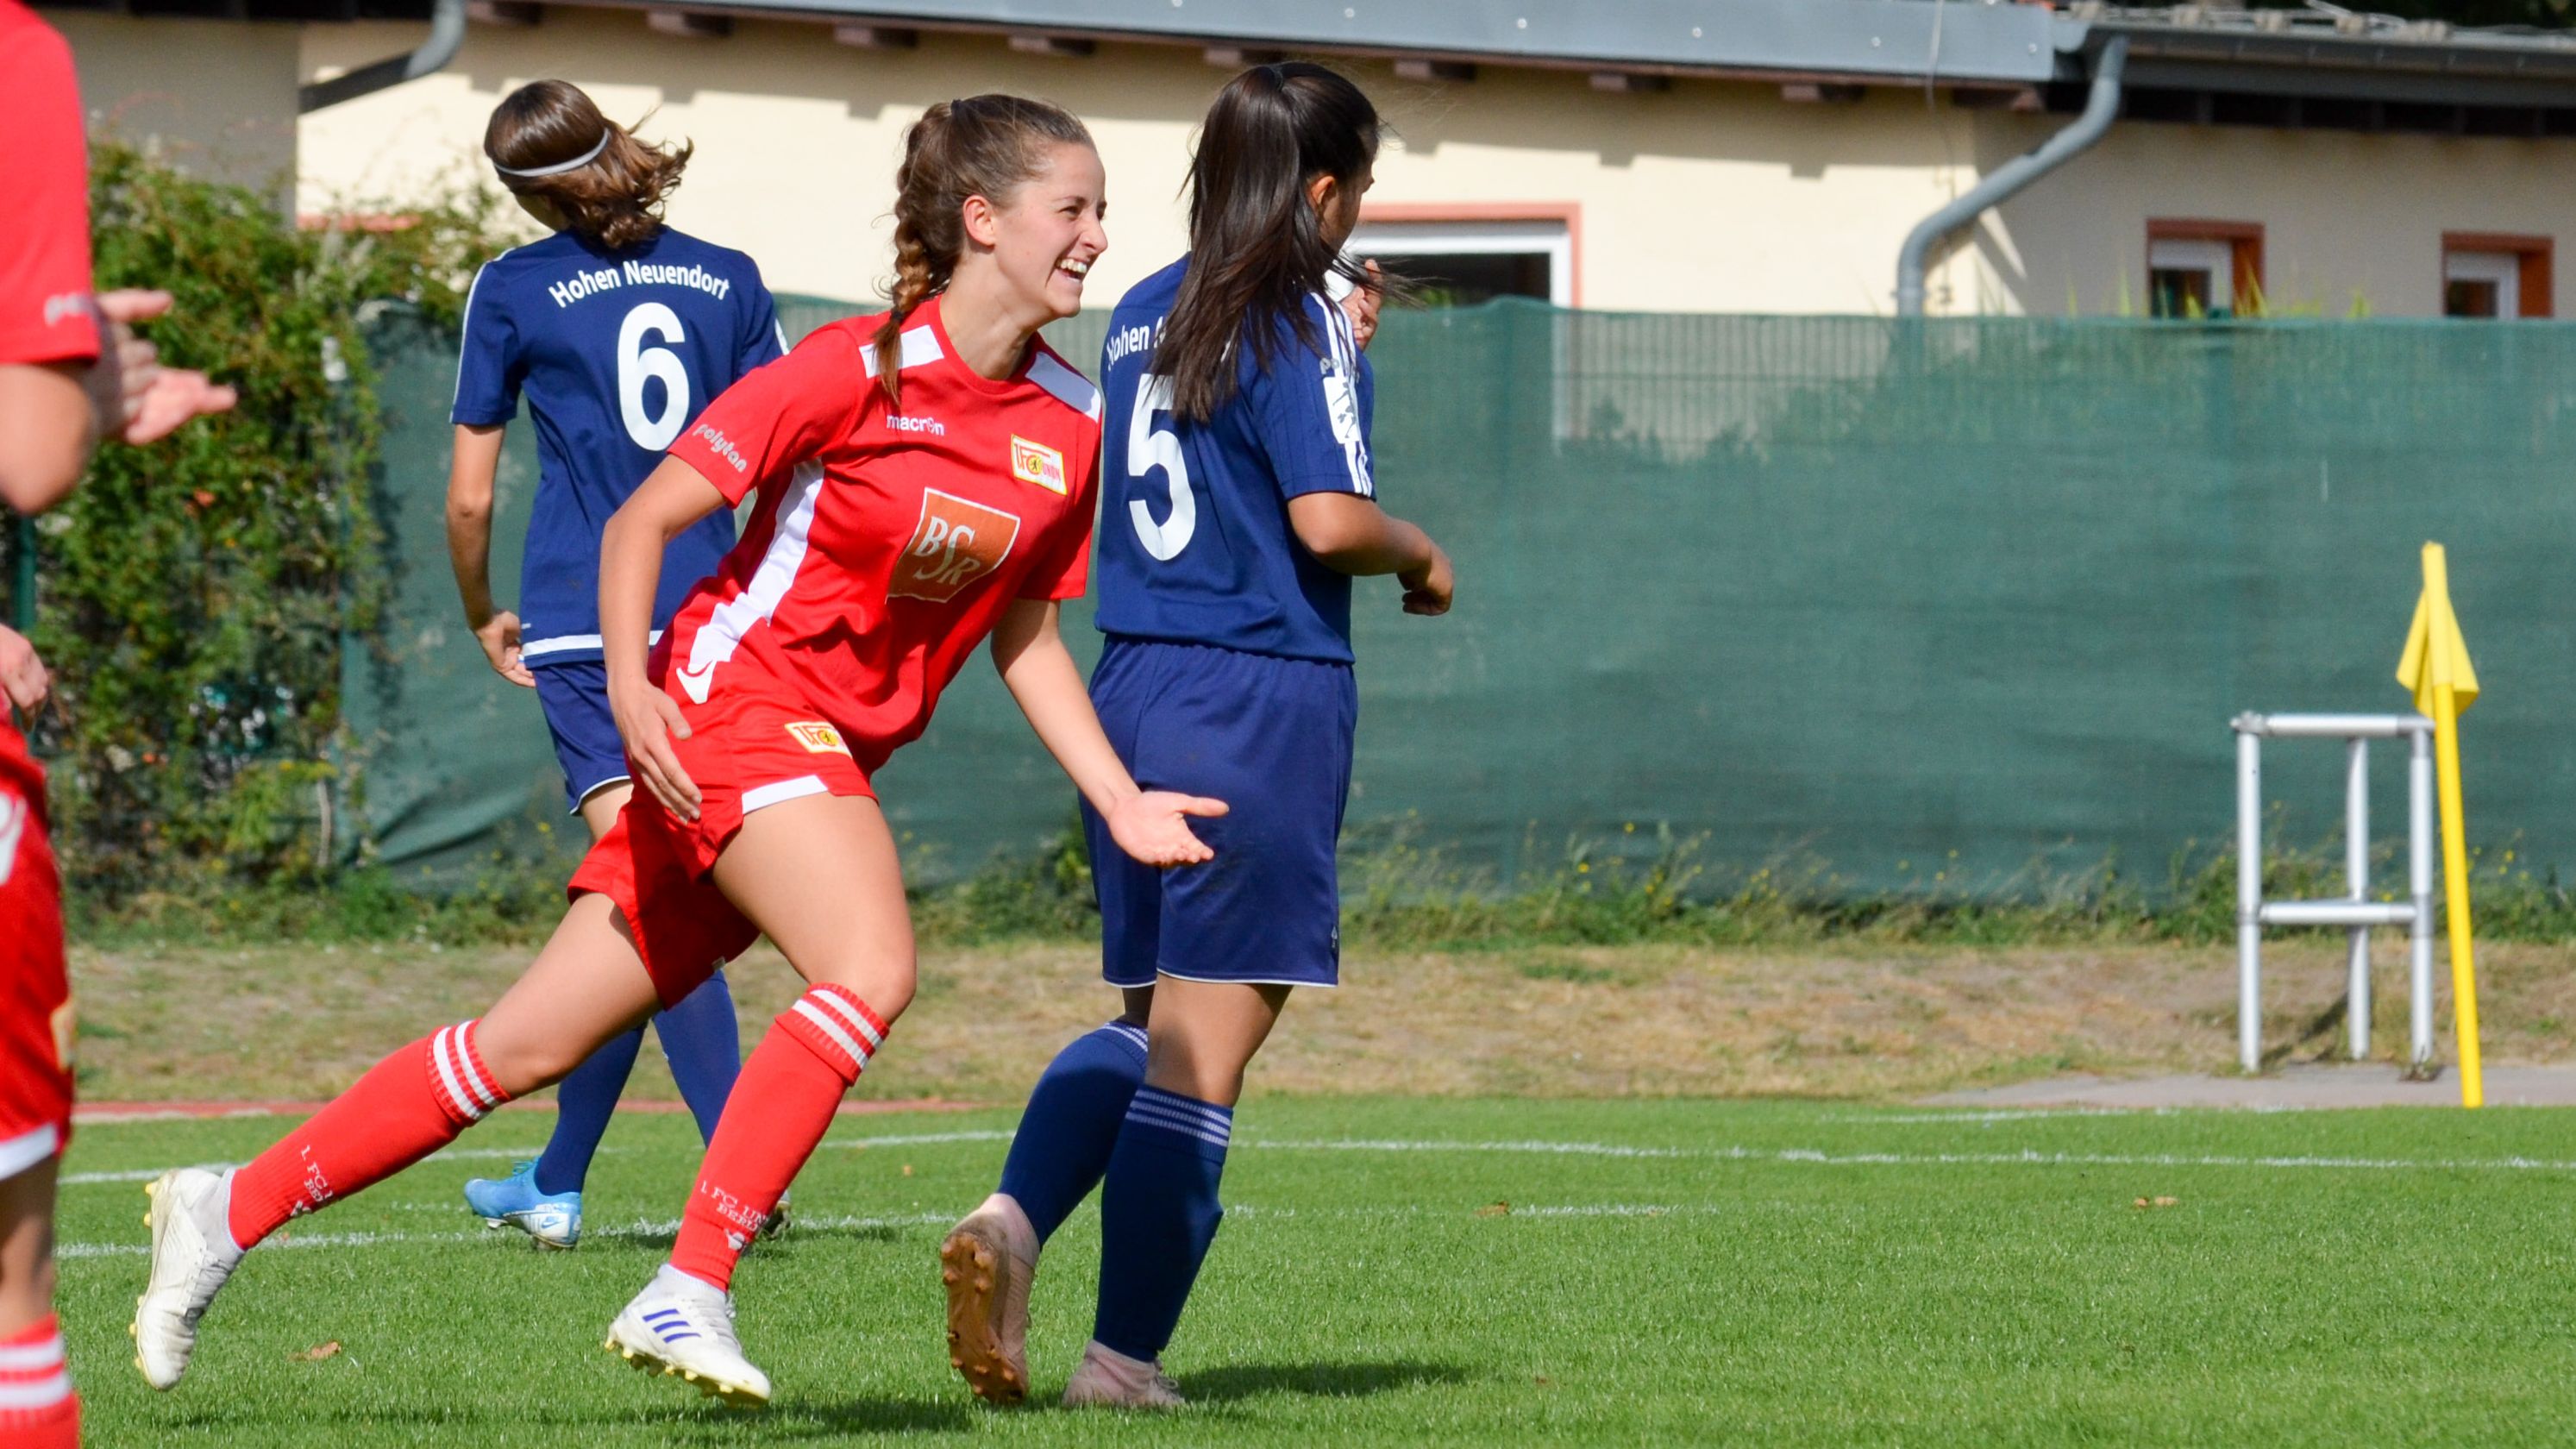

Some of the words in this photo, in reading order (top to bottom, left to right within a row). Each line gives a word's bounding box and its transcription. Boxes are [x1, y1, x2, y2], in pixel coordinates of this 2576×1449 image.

[548, 268, 622, 308] Hohen
[617, 302, 690, 451] 6
[692, 423, 748, 473] polytan
[886, 414, 945, 436] macron
[1127, 373, 1196, 561] 5
